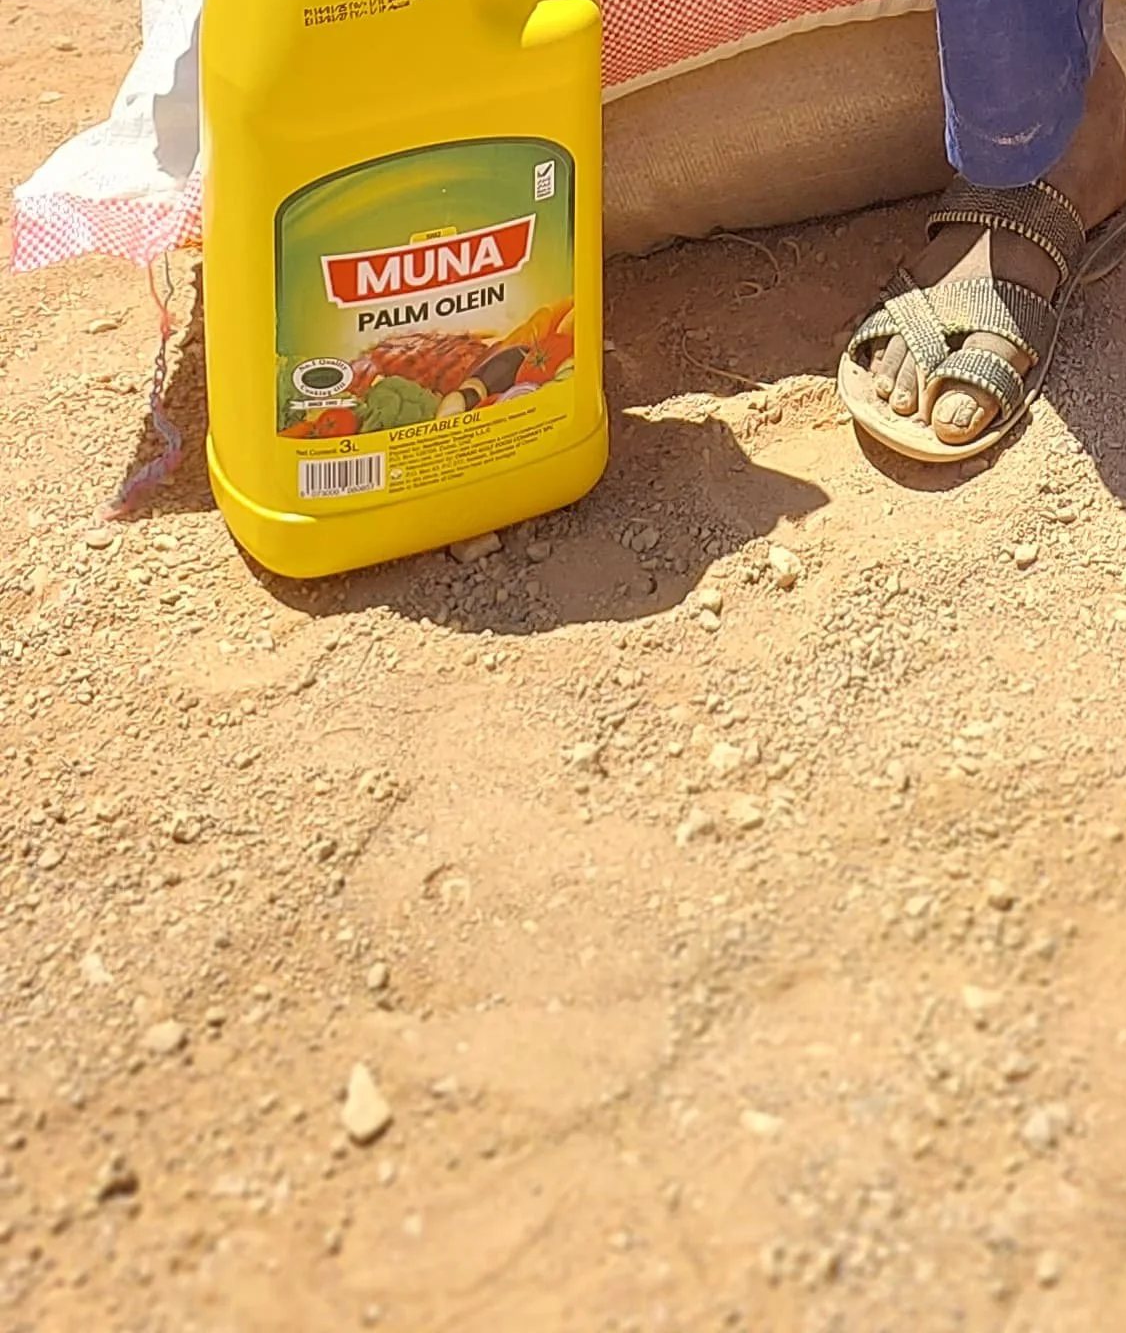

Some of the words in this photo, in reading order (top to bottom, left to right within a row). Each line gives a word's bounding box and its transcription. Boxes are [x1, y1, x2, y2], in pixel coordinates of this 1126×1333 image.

[357, 236, 503, 296] MUNA
[358, 302, 429, 332] PALM
[435, 283, 504, 317] OLEIN
[389, 416, 460, 442] VEGETABLE
[463, 412, 481, 425] OIL
